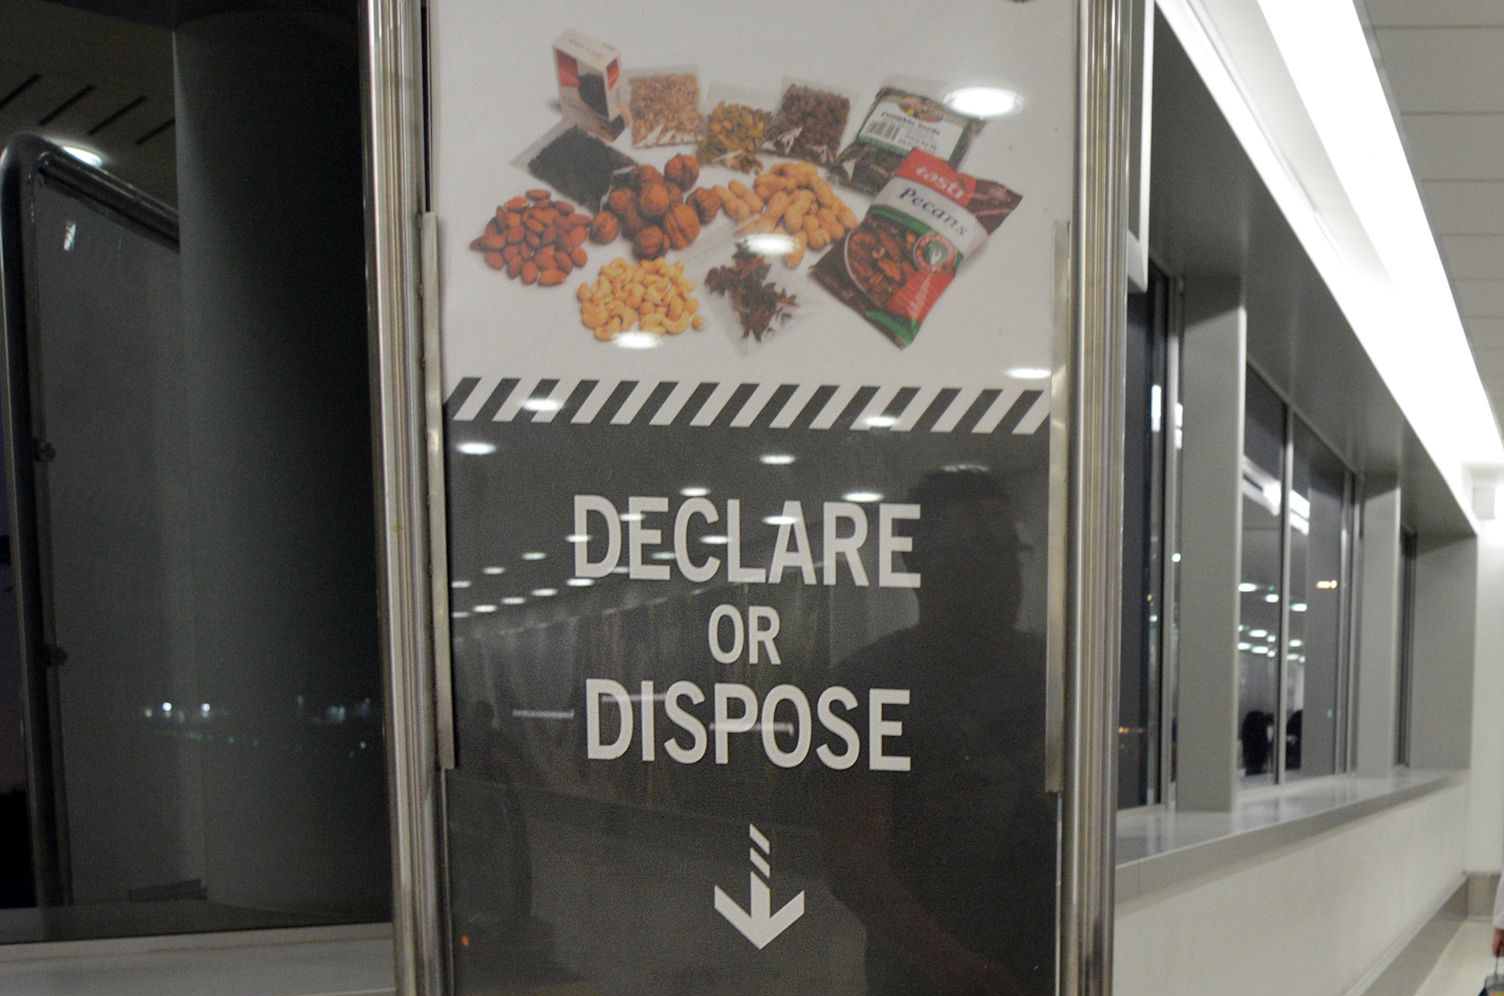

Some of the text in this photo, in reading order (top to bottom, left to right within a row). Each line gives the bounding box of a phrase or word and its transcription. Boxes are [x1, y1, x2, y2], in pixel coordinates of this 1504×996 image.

[899, 186, 968, 238] Pecans
[574, 494, 921, 588] DECLARE
[708, 603, 782, 665] OR
[586, 677, 911, 772] DISPOSE
